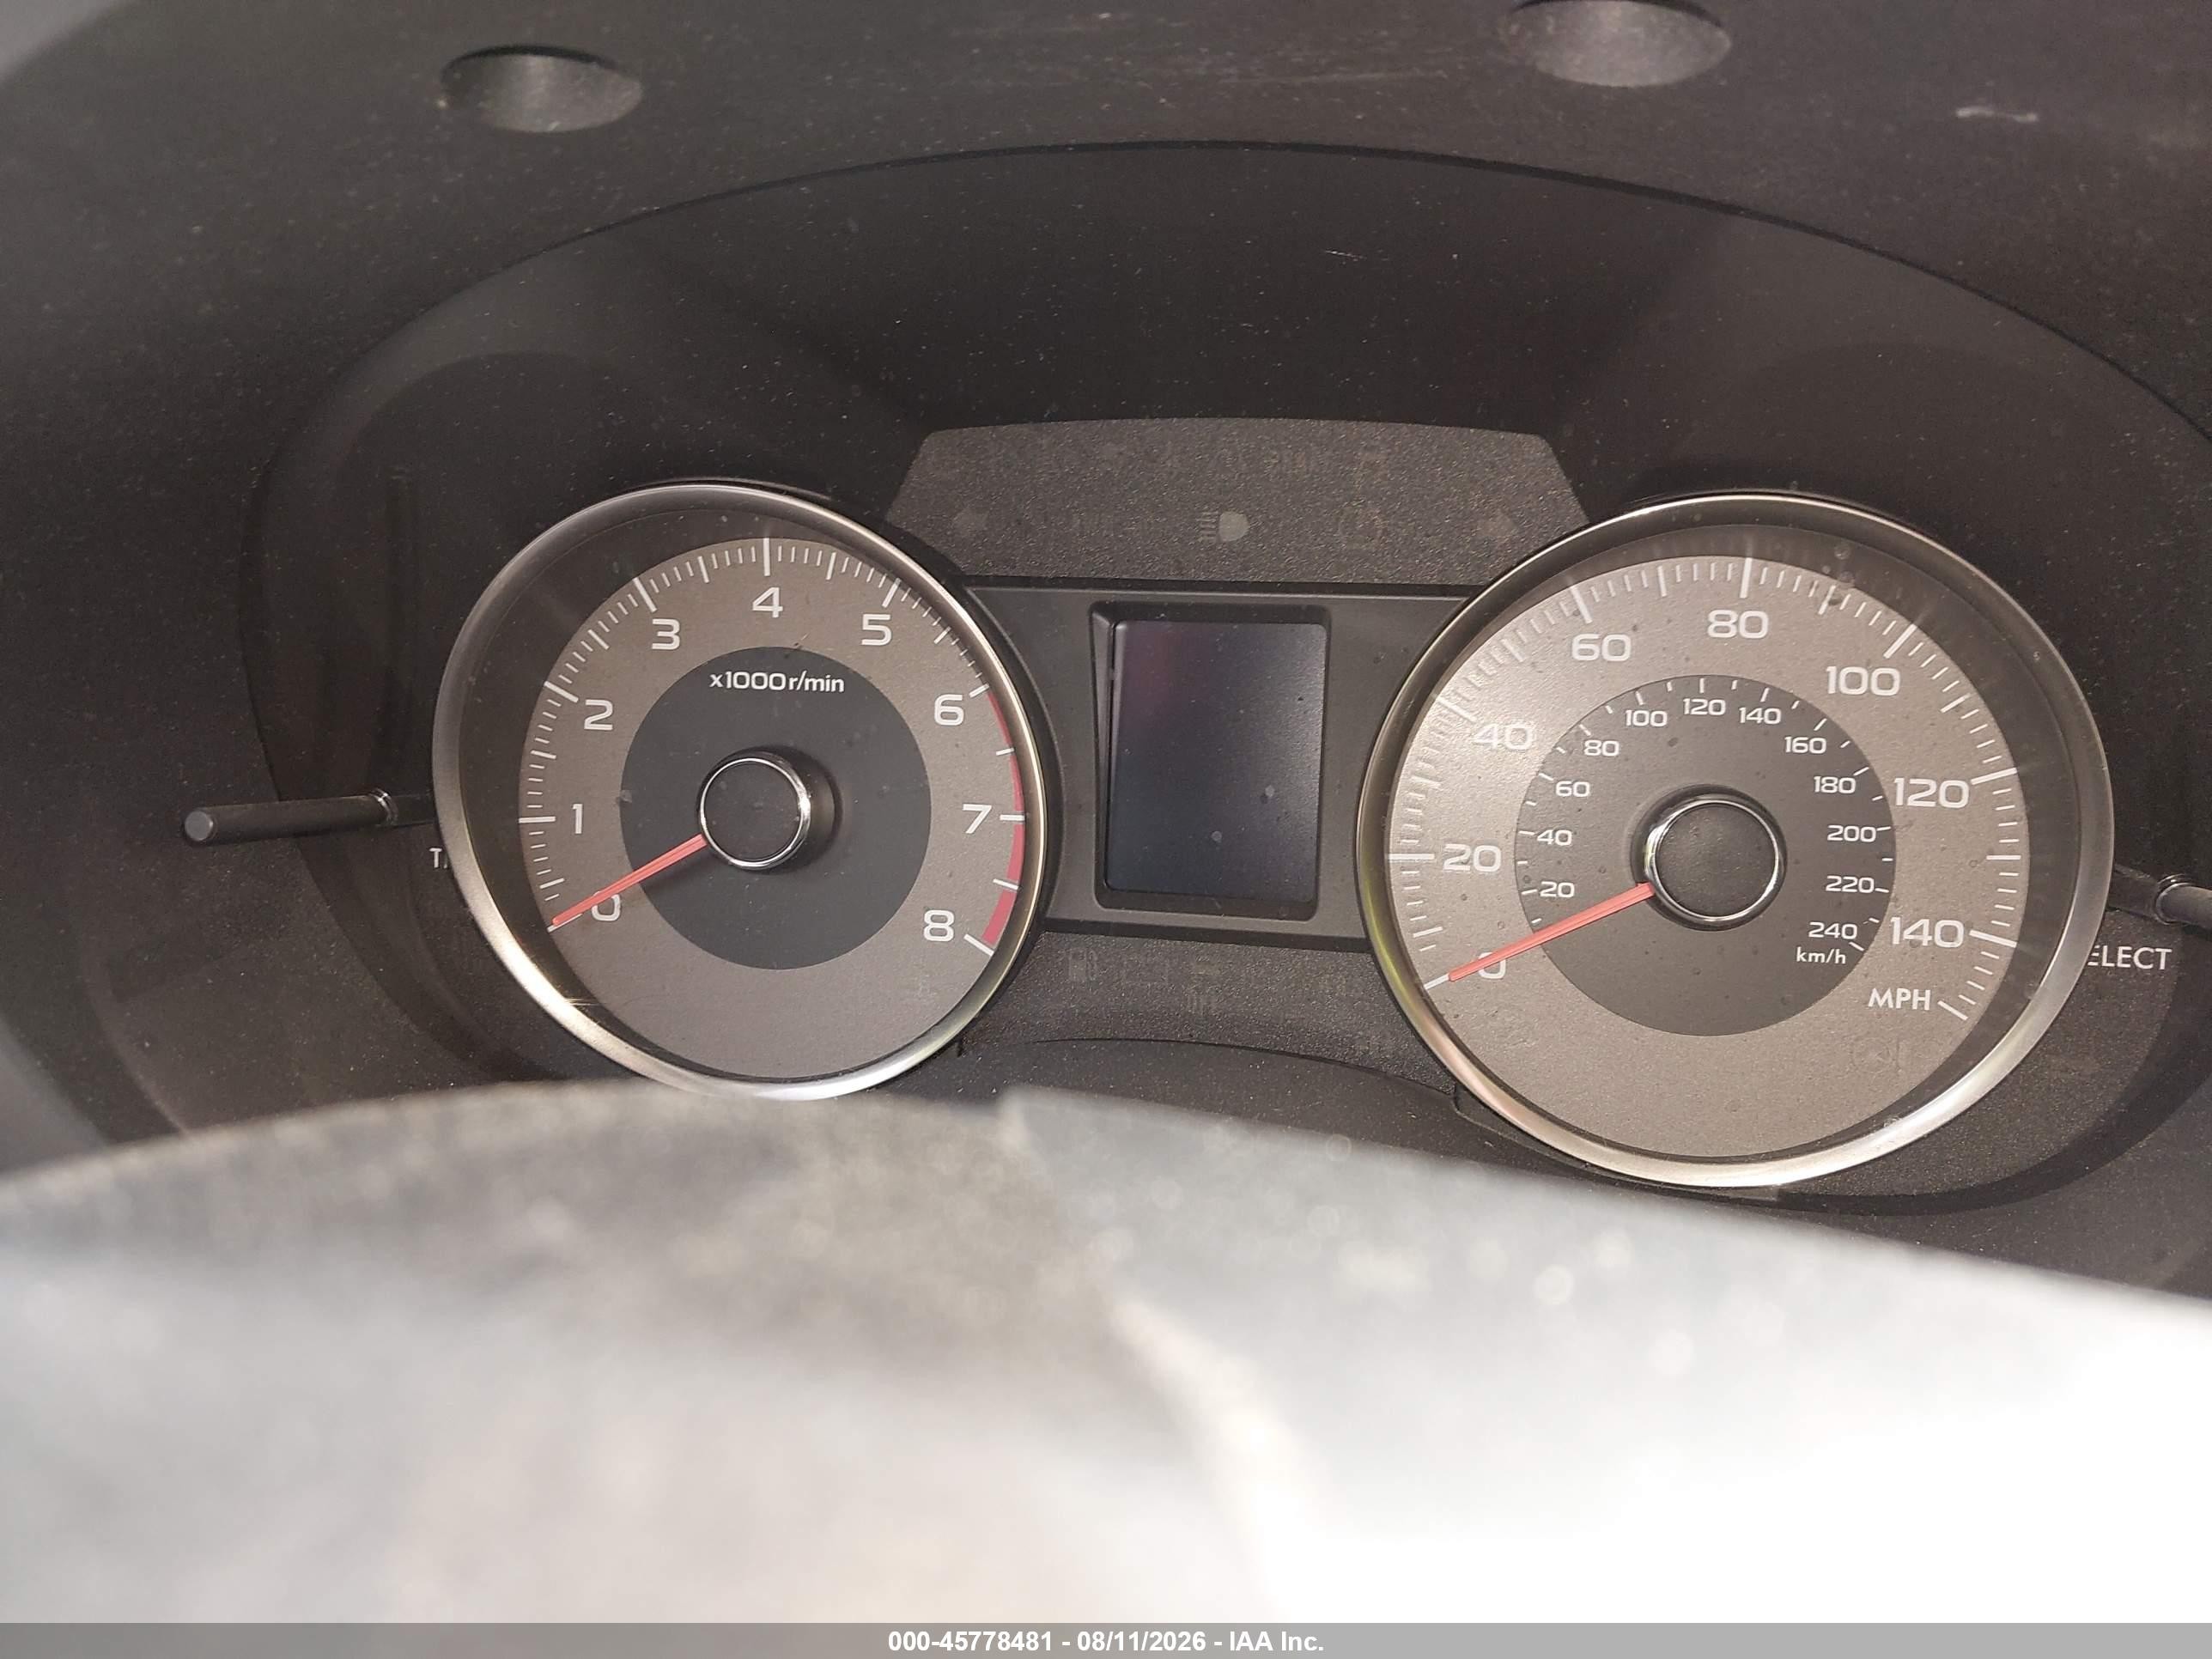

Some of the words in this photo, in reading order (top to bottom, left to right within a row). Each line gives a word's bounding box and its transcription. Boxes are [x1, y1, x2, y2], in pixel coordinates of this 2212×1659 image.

[752, 586, 783, 618] 4
[651, 618, 681, 651] 3
[861, 613, 892, 646] 5
[1708, 610, 1769, 639] 80
[1571, 633, 1632, 661] 60
[709, 671, 787, 690] x1000
[788, 670, 845, 692] r/min
[1826, 665, 1901, 696] 100
[583, 698, 614, 731] 2
[934, 693, 965, 726] 6
[1626, 709, 1668, 727] 100
[1683, 698, 1726, 717] 120
[1739, 707, 1782, 725] 140
[1472, 723, 1533, 752] 40
[1583, 739, 1620, 757] 80
[1784, 736, 1827, 755] 160
[1555, 781, 1590, 798] 60
[1814, 775, 1856, 793] 180
[1893, 778, 1970, 809] 120
[572, 803, 584, 835] 1
[962, 804, 992, 834] 7
[1536, 829, 1573, 847] 40
[1827, 825, 1876, 843] 200
[1443, 842, 1502, 872] 20
[1540, 881, 1575, 898] 20
[1826, 875, 1875, 894] 220
[591, 890, 622, 921] 0
[923, 909, 955, 943] 8
[1808, 921, 1858, 940] 240
[1890, 916, 1965, 948] 140
[1477, 951, 1506, 979] 0
[1796, 946, 1846, 964] km/h
[1868, 988, 1931, 1011] MPH
